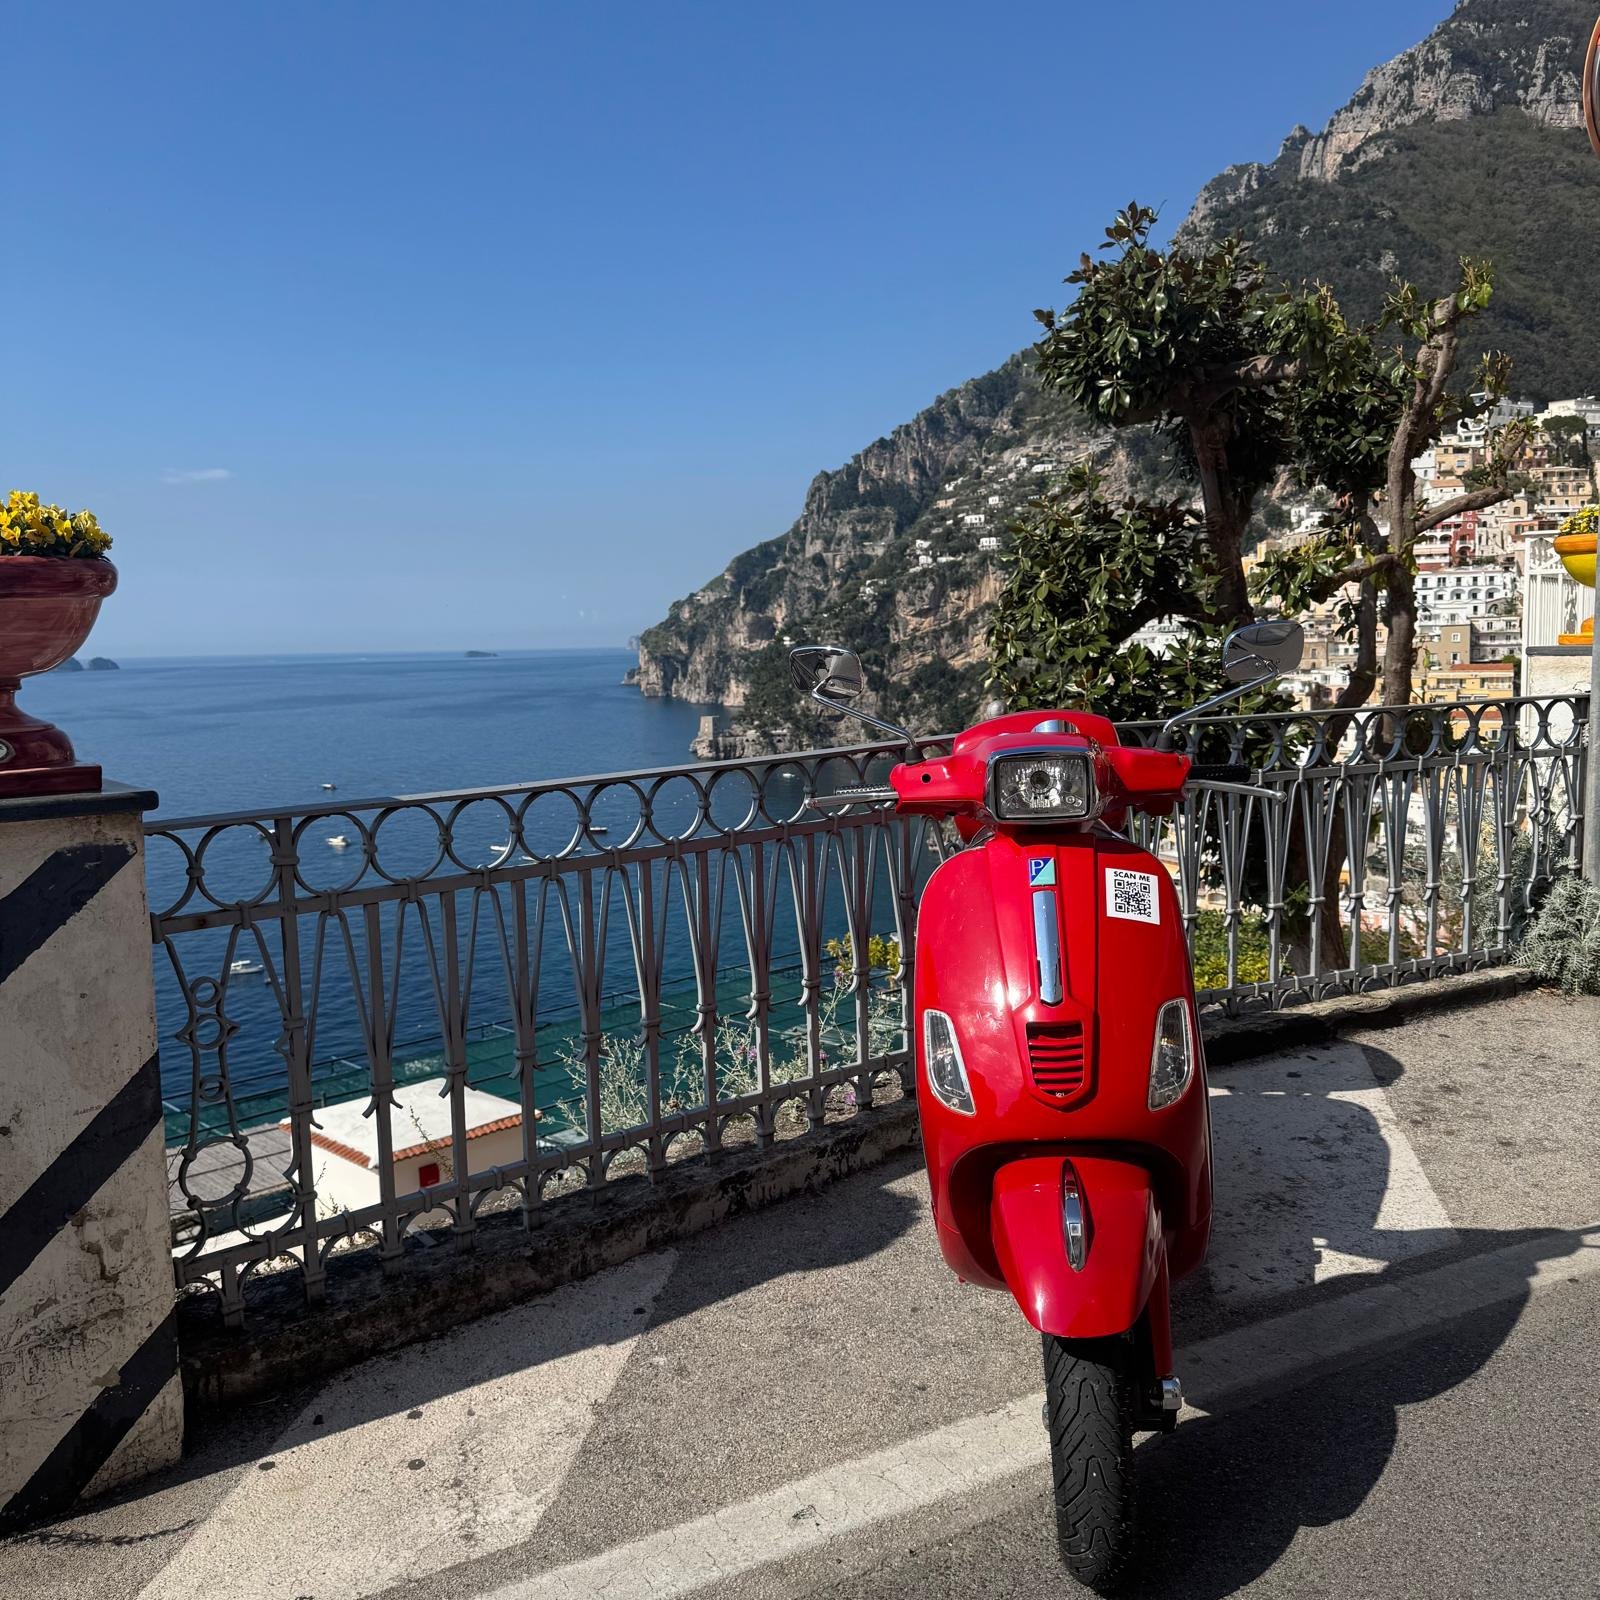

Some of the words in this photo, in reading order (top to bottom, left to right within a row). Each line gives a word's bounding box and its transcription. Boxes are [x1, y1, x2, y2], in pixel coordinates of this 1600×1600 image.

[1030, 859, 1044, 876] P
[1113, 870, 1136, 880] SCAN
[1138, 874, 1151, 883] ME
